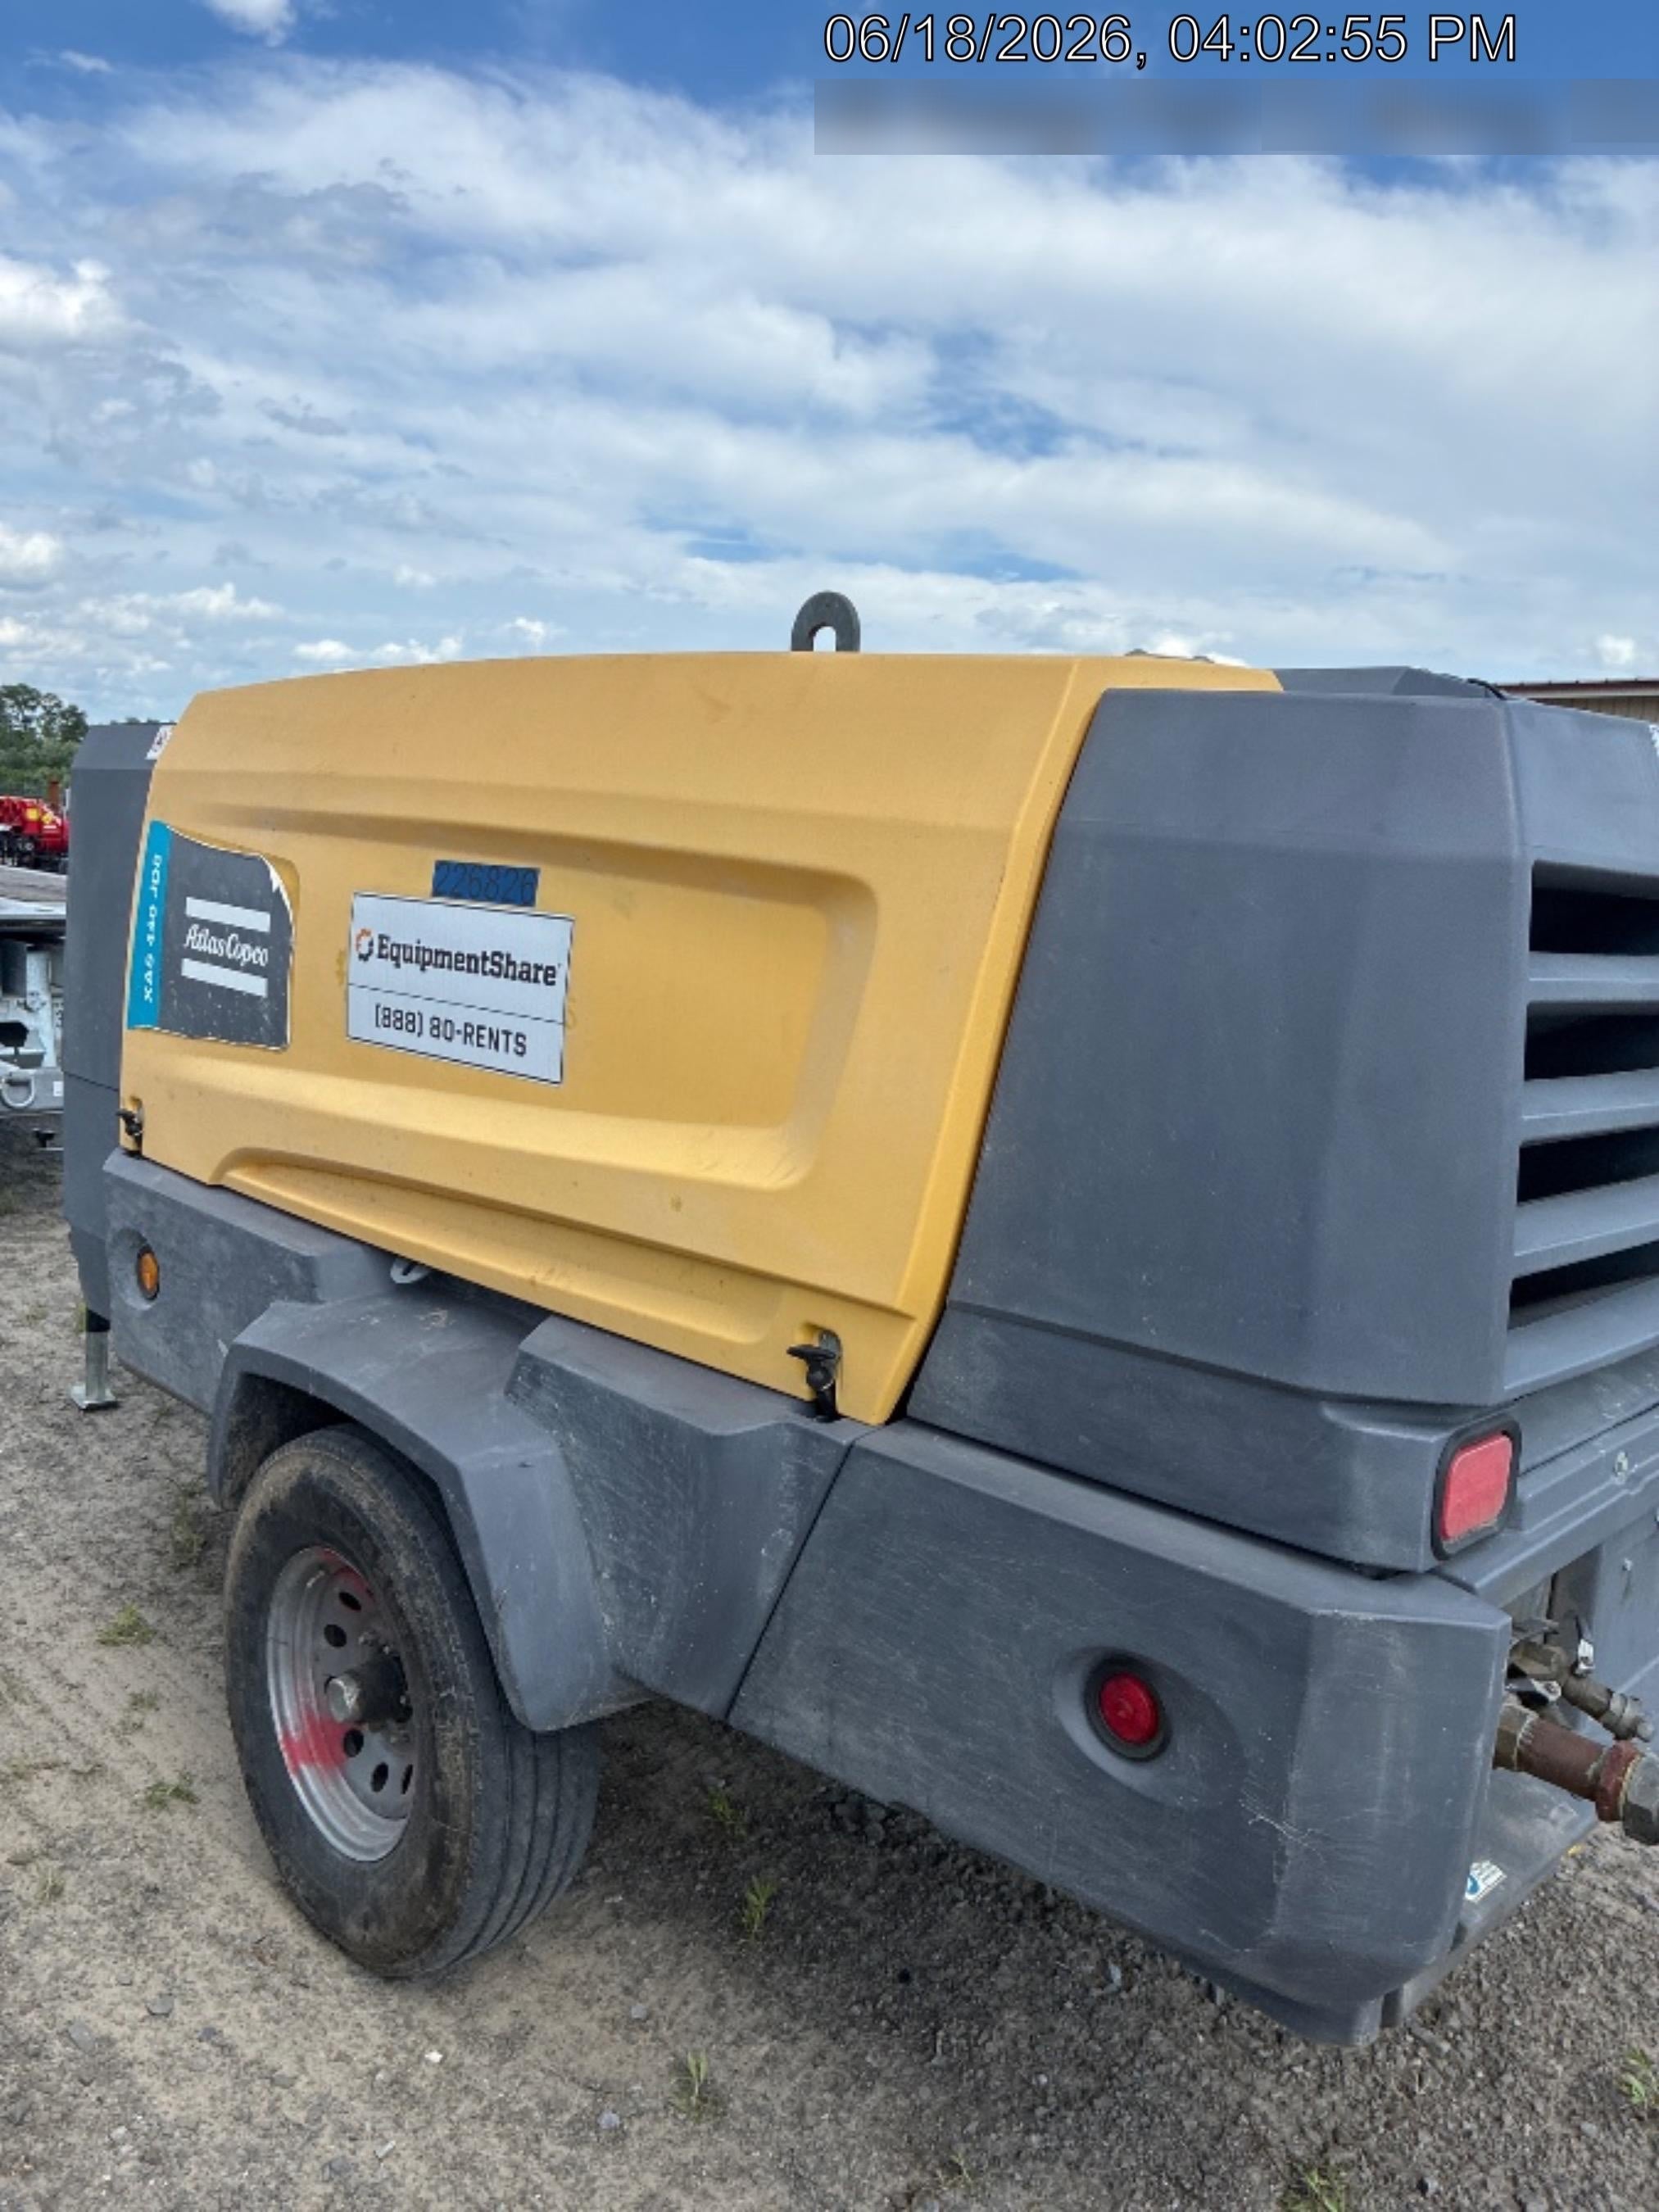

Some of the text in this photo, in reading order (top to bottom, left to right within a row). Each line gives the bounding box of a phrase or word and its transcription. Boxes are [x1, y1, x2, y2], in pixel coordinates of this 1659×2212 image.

[184, 923, 269, 968] Atlas Copco
[377, 933, 557, 986] EquipmentShare
[428, 1016, 528, 1058] 80-RENTS
